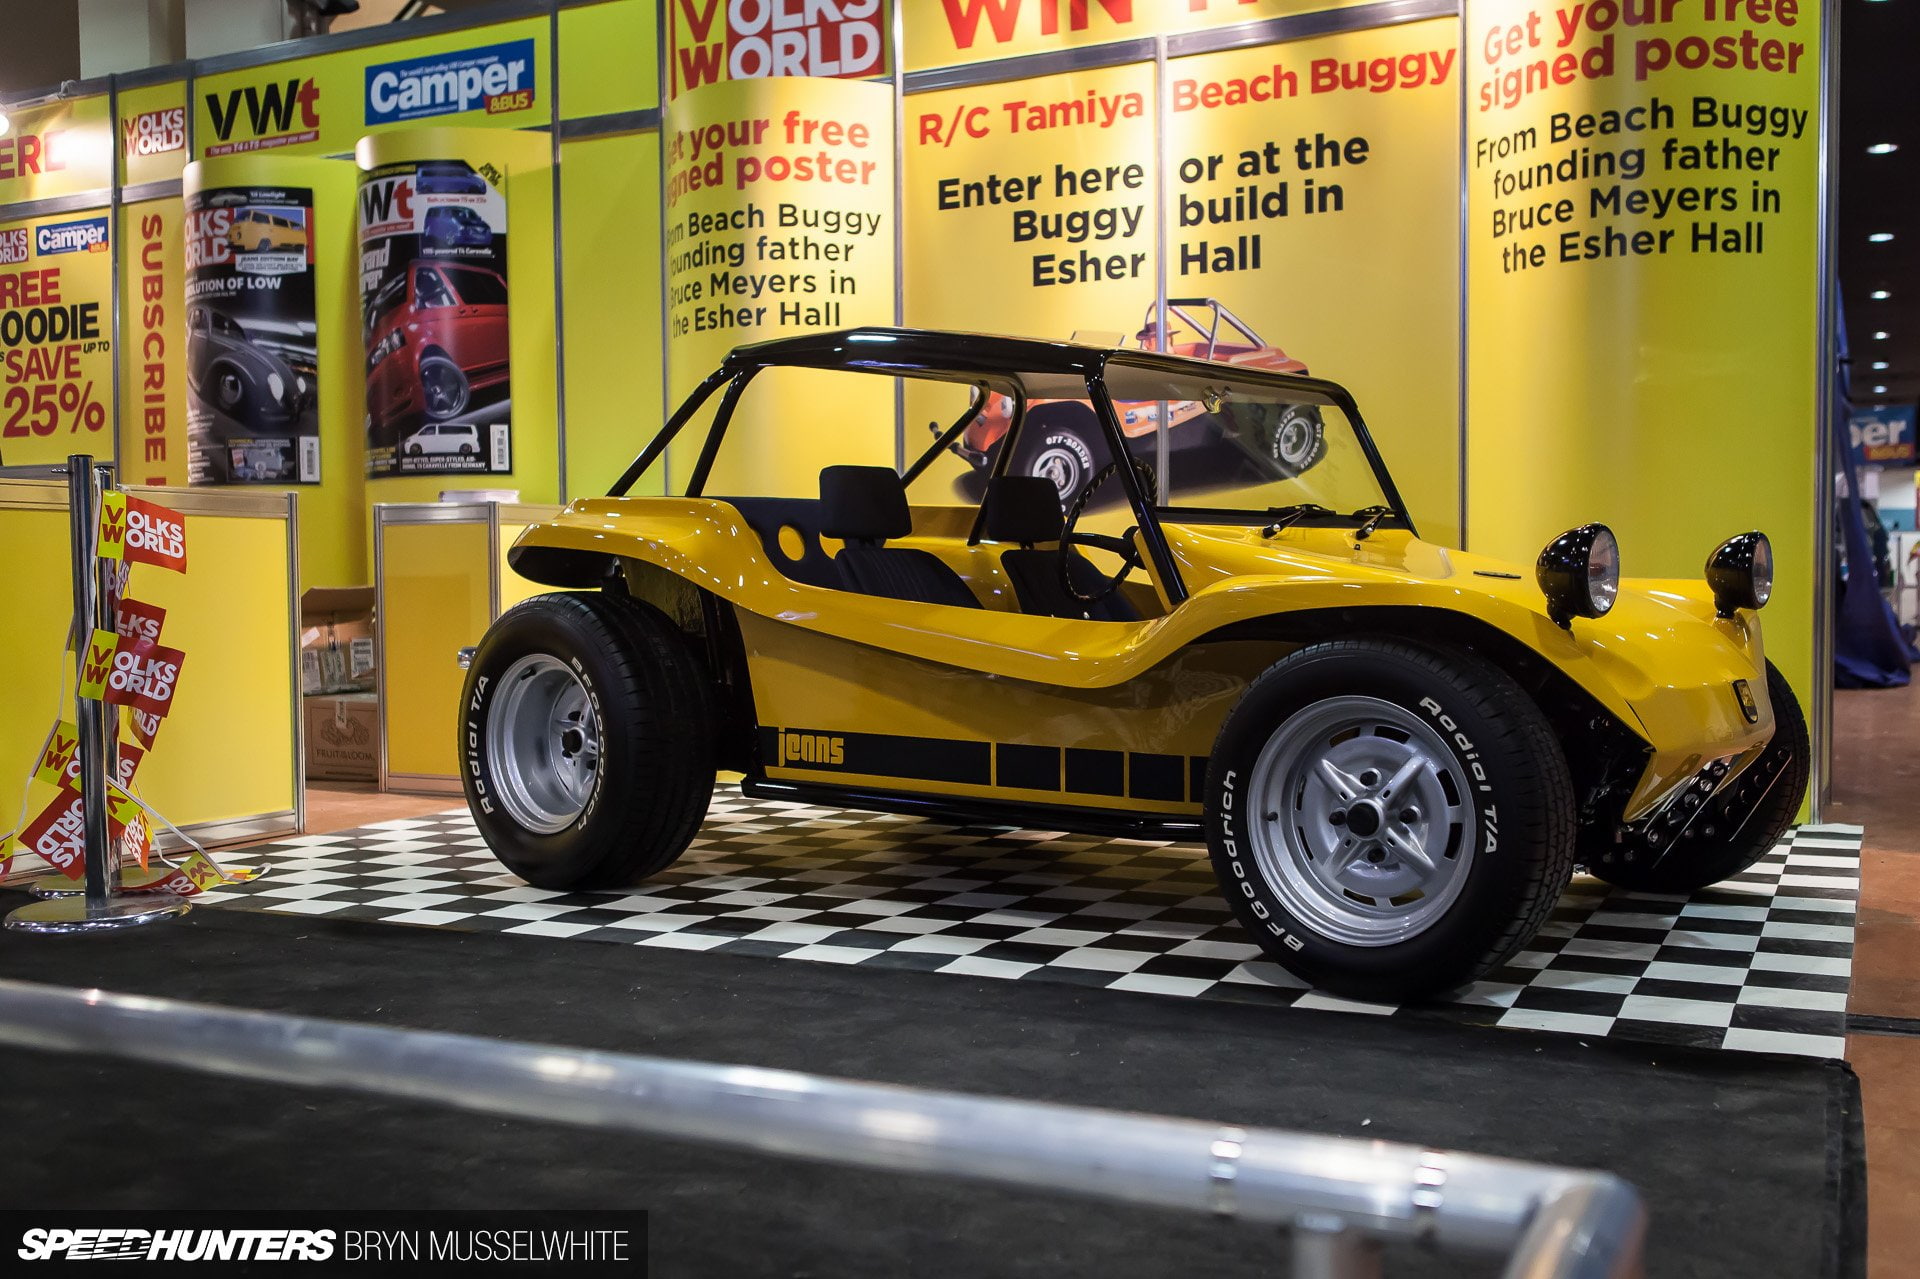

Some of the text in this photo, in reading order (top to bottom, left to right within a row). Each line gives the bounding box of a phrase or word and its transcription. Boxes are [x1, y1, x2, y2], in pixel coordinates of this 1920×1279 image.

[679, 21, 880, 90] WORLD
[1484, 11, 1541, 65] Get
[1556, 0, 1683, 48] your
[371, 59, 525, 113] Camper
[1480, 30, 1804, 112] signed poster
[205, 77, 320, 141] VWt
[491, 93, 528, 112] &BUS
[920, 49, 1456, 147] R/C Tamiya Beach Buggy
[124, 108, 184, 137] VOLKS
[124, 130, 184, 156] WORLD
[690, 119, 769, 161] your
[783, 111, 870, 148] free
[1477, 97, 1808, 168] From Beach Buggy
[737, 152, 876, 190] poster
[938, 133, 1370, 210] Enter here or at the
[1494, 139, 1780, 199] founding father
[688, 203, 764, 237] Beach
[779, 204, 881, 236] Buggy
[1013, 178, 1344, 243] Buggy build in
[1493, 180, 1780, 238] Bruce Meyers in
[38, 226, 105, 251] Camper
[757, 236, 854, 261] father
[1033, 235, 1260, 287] Esher Hall
[1503, 222, 1763, 273] the Esher Hall
[227, 278, 243, 290] OF
[247, 277, 281, 290] LOW
[711, 272, 817, 298] Meyers
[830, 270, 856, 294] in
[1, 302, 99, 347] OODIE
[142, 214, 166, 463] SUBSCRIBE
[673, 302, 840, 339] the Esher Hall
[6, 344, 82, 384] SAVE
[83, 343, 97, 354] UP
[98, 341, 110, 352] TO
[3, 380, 105, 438] 25%
[1046, 435, 1090, 470] OFF-ROADER
[102, 523, 184, 559] WORLD
[105, 505, 184, 542] VOLKS
[87, 664, 171, 701] WORLD
[93, 645, 177, 684] VOLKS
[471, 676, 489, 711] T/A
[469, 722, 494, 814] Radial
[778, 727, 844, 767] jeans
[1420, 697, 1498, 853] Radial T/A
[1221, 770, 1305, 952] BFGoodrich
